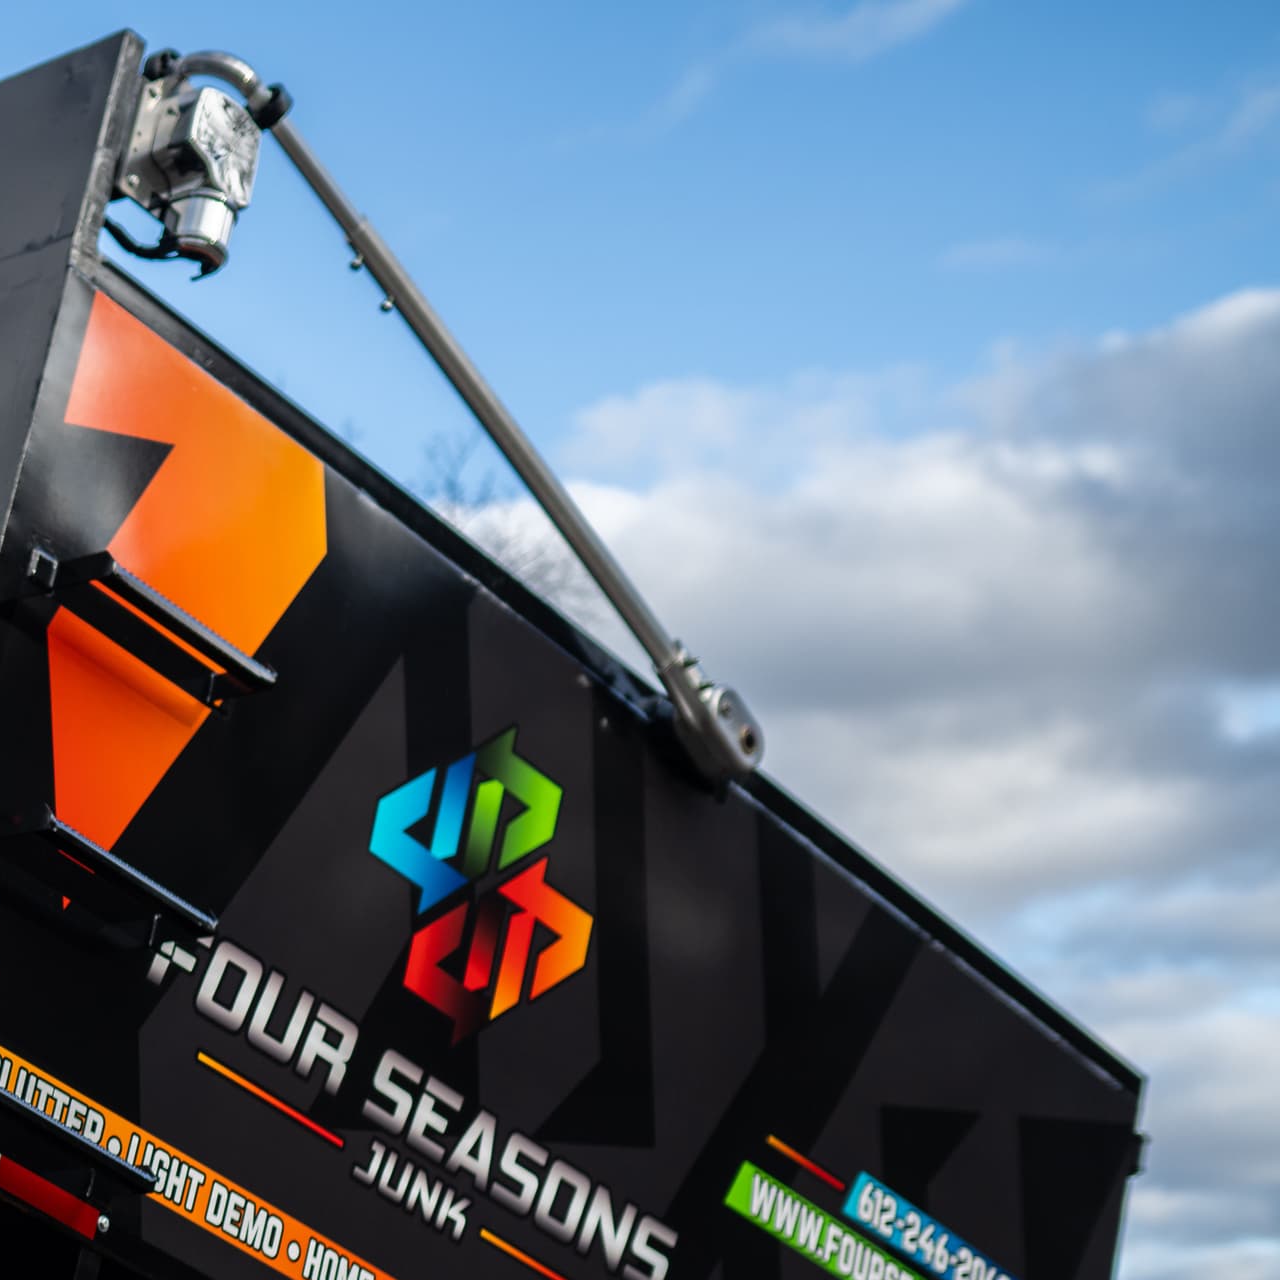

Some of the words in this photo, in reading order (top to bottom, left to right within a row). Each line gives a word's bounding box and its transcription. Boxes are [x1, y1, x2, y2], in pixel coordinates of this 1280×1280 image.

[146, 936, 359, 1096] FOUR
[205, 1181, 283, 1260] DEMO
[352, 1140, 471, 1241] JUNK
